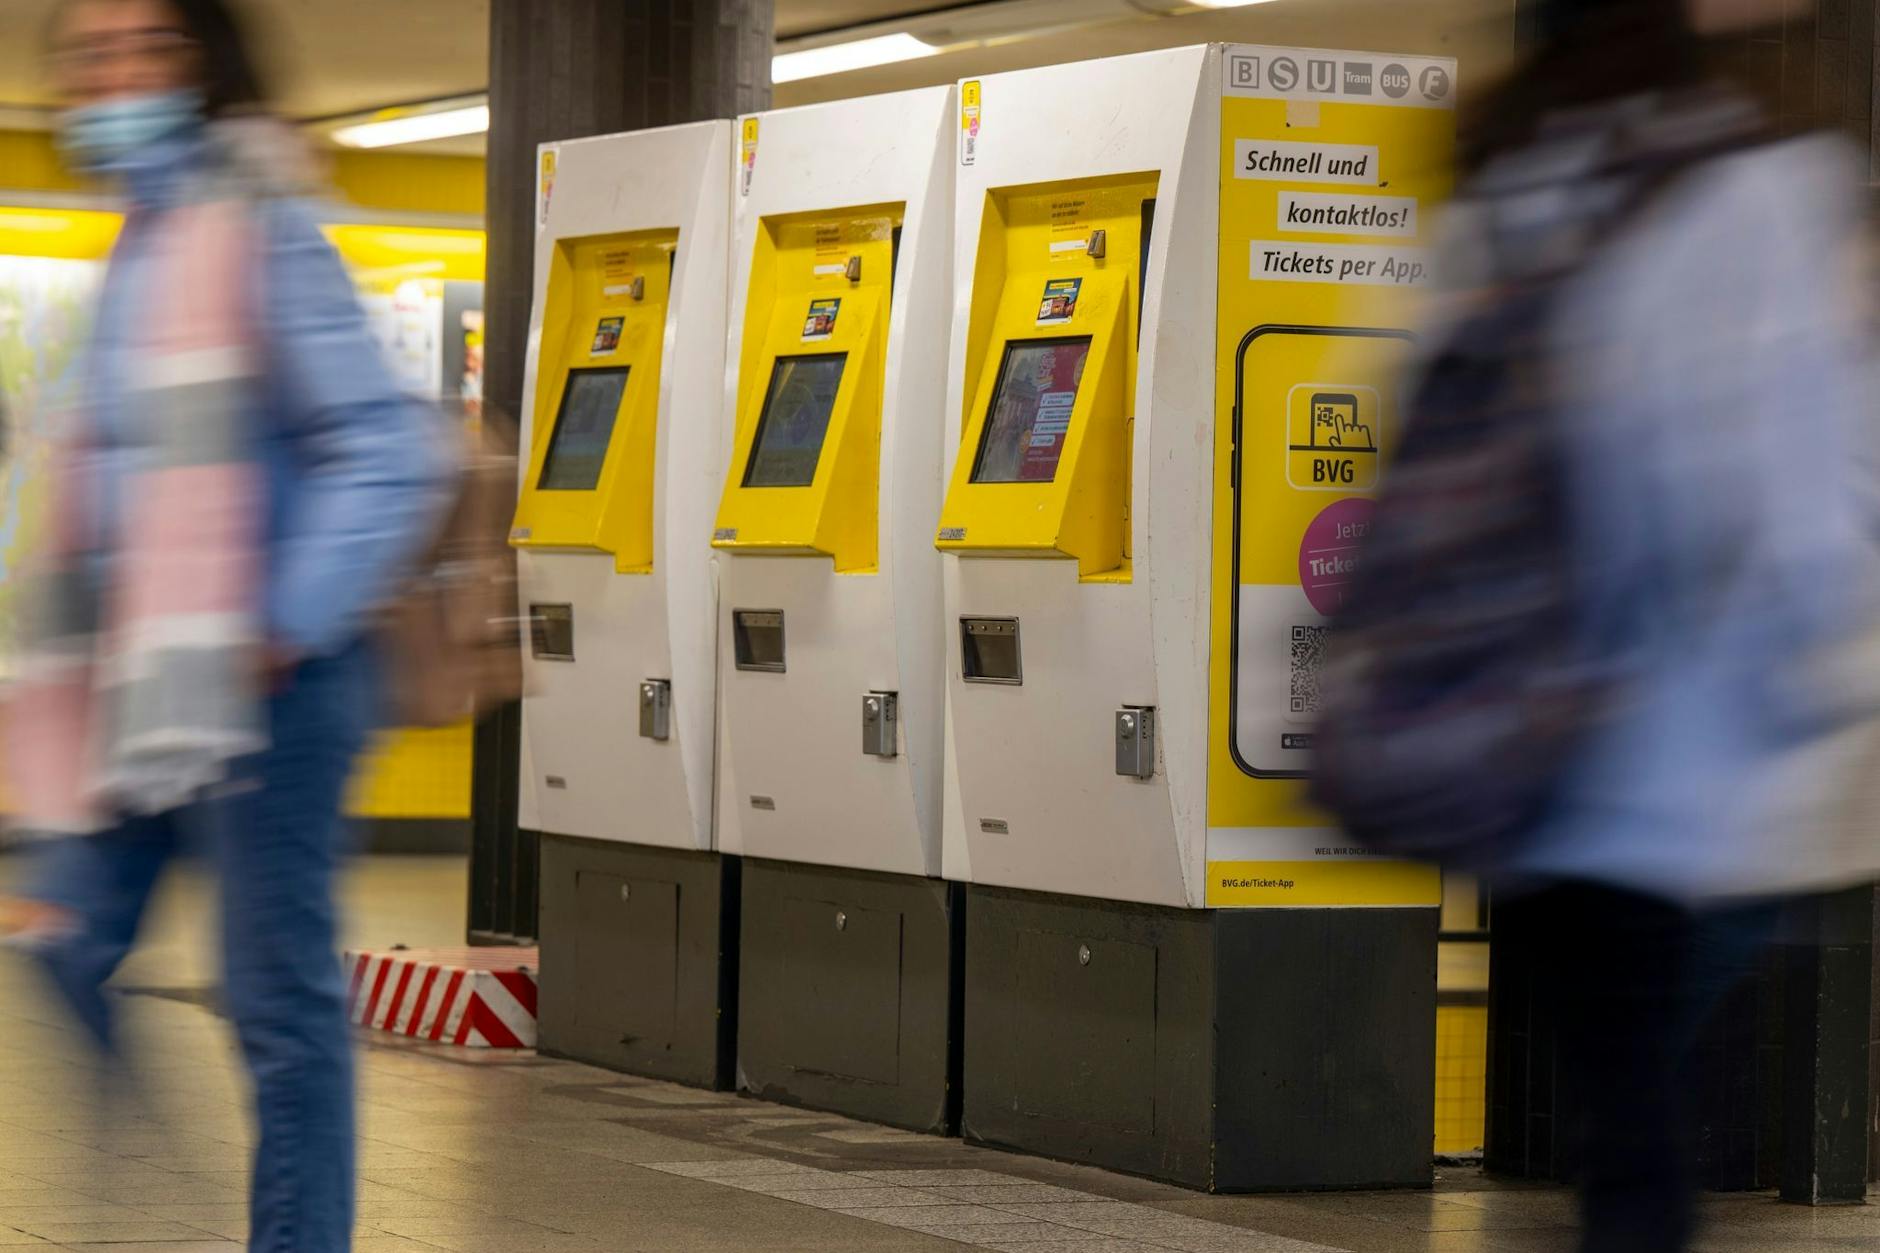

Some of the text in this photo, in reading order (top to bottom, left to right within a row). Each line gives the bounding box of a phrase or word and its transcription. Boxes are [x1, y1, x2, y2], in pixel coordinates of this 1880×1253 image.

[1238, 59, 1442, 95] B S U Tram BUS F
[1245, 150, 1368, 176] Schnell und
[1287, 201, 1408, 228] kontaktlos!
[1263, 251, 1428, 283] Tickets per App.
[1312, 459, 1354, 483] BVG
[1314, 847, 1331, 856] WEIL
[1333, 847, 1348, 856] WIR
[1222, 878, 1294, 889] BVG.de/Ticket-App
